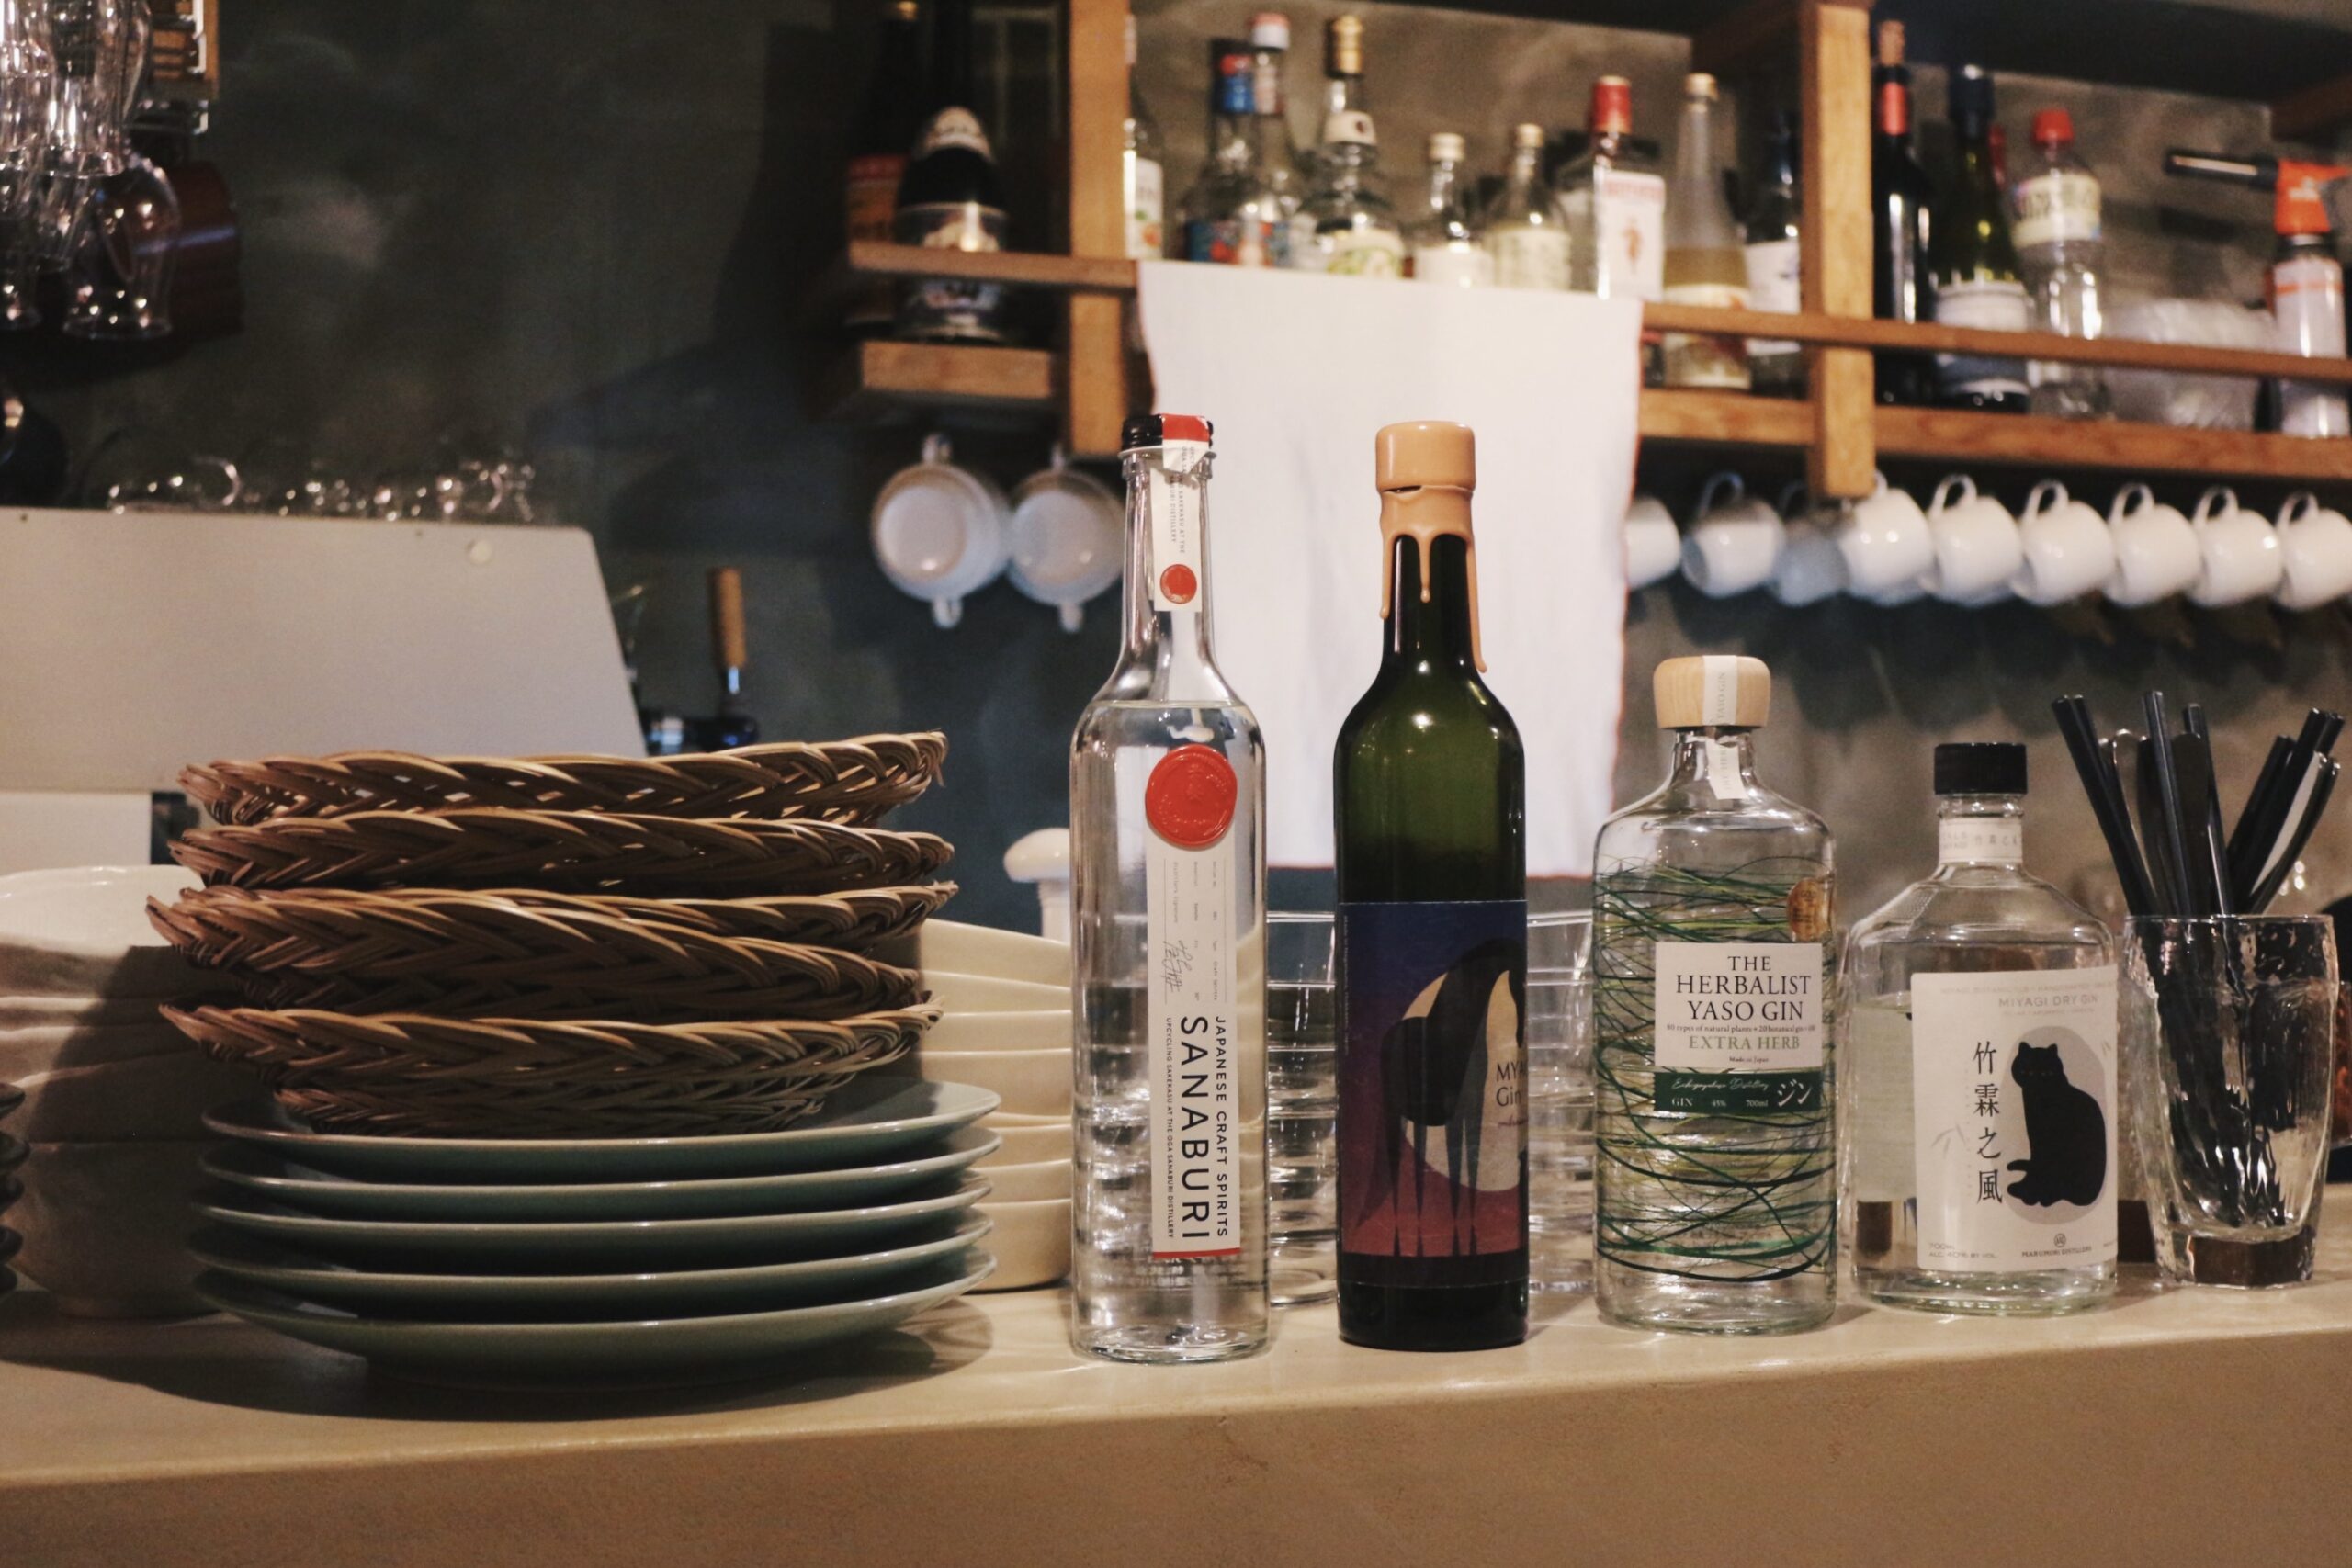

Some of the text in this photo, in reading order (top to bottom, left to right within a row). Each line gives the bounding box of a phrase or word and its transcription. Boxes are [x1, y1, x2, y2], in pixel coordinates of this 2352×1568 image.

[1727, 956, 1771, 971] THE
[1676, 975, 1812, 995] HERBALIST
[1688, 1000, 1804, 1021] YASO GIN
[1998, 994, 2098, 1008] MIYAGI DRY GIN
[1689, 1036, 1801, 1050] EXTRA HERB
[1496, 1087, 1521, 1107] Gin
[1671, 1097, 1694, 1107] GIN
[1777, 1078, 1813, 1108] ジン
[1181, 1016, 1210, 1237] SANABURI
[1216, 1016, 1227, 1237] JAPANESE CRAFT SPIRITS
